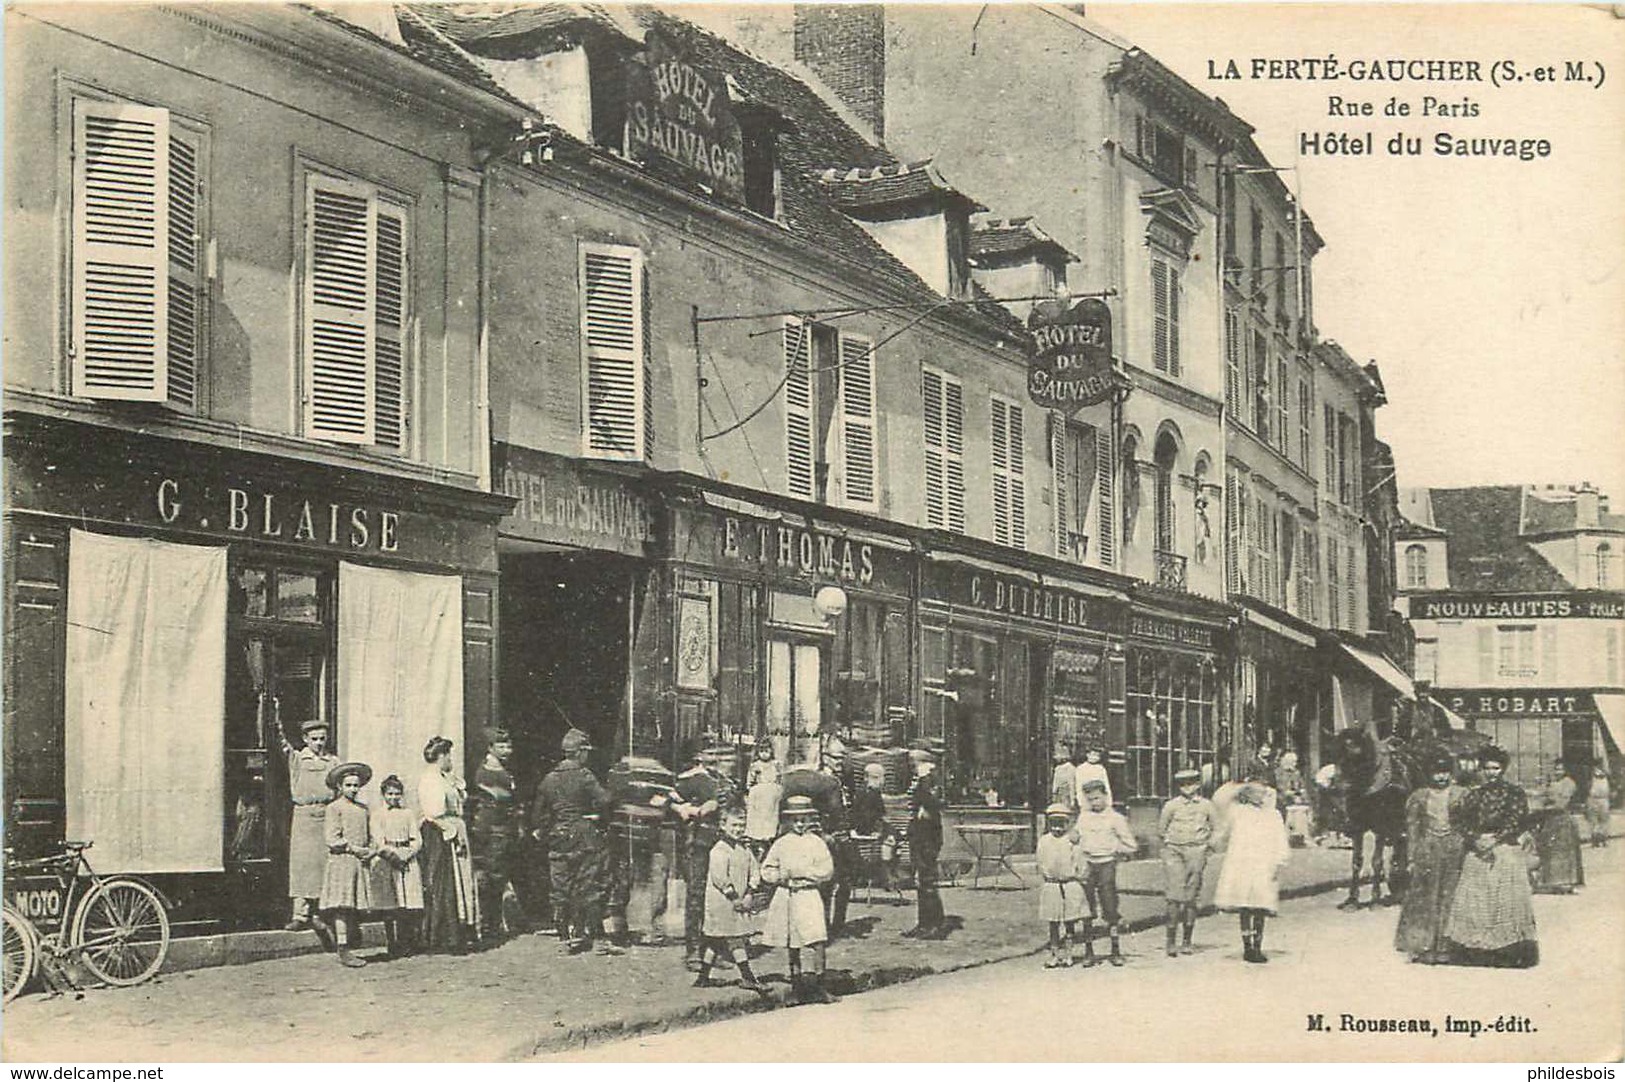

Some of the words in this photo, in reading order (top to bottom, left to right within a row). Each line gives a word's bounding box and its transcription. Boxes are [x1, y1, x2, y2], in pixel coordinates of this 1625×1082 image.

[678, 104, 697, 125] DU
[1057, 353, 1084, 369] DU
[157, 479, 209, 528] G.
[227, 488, 399, 551] BLAISE
[724, 516, 752, 560] E.
[757, 523, 873, 584] THOMAS
[1426, 600, 1571, 617] NOUVEAUTES
[1480, 697, 1577, 713] HOBART
